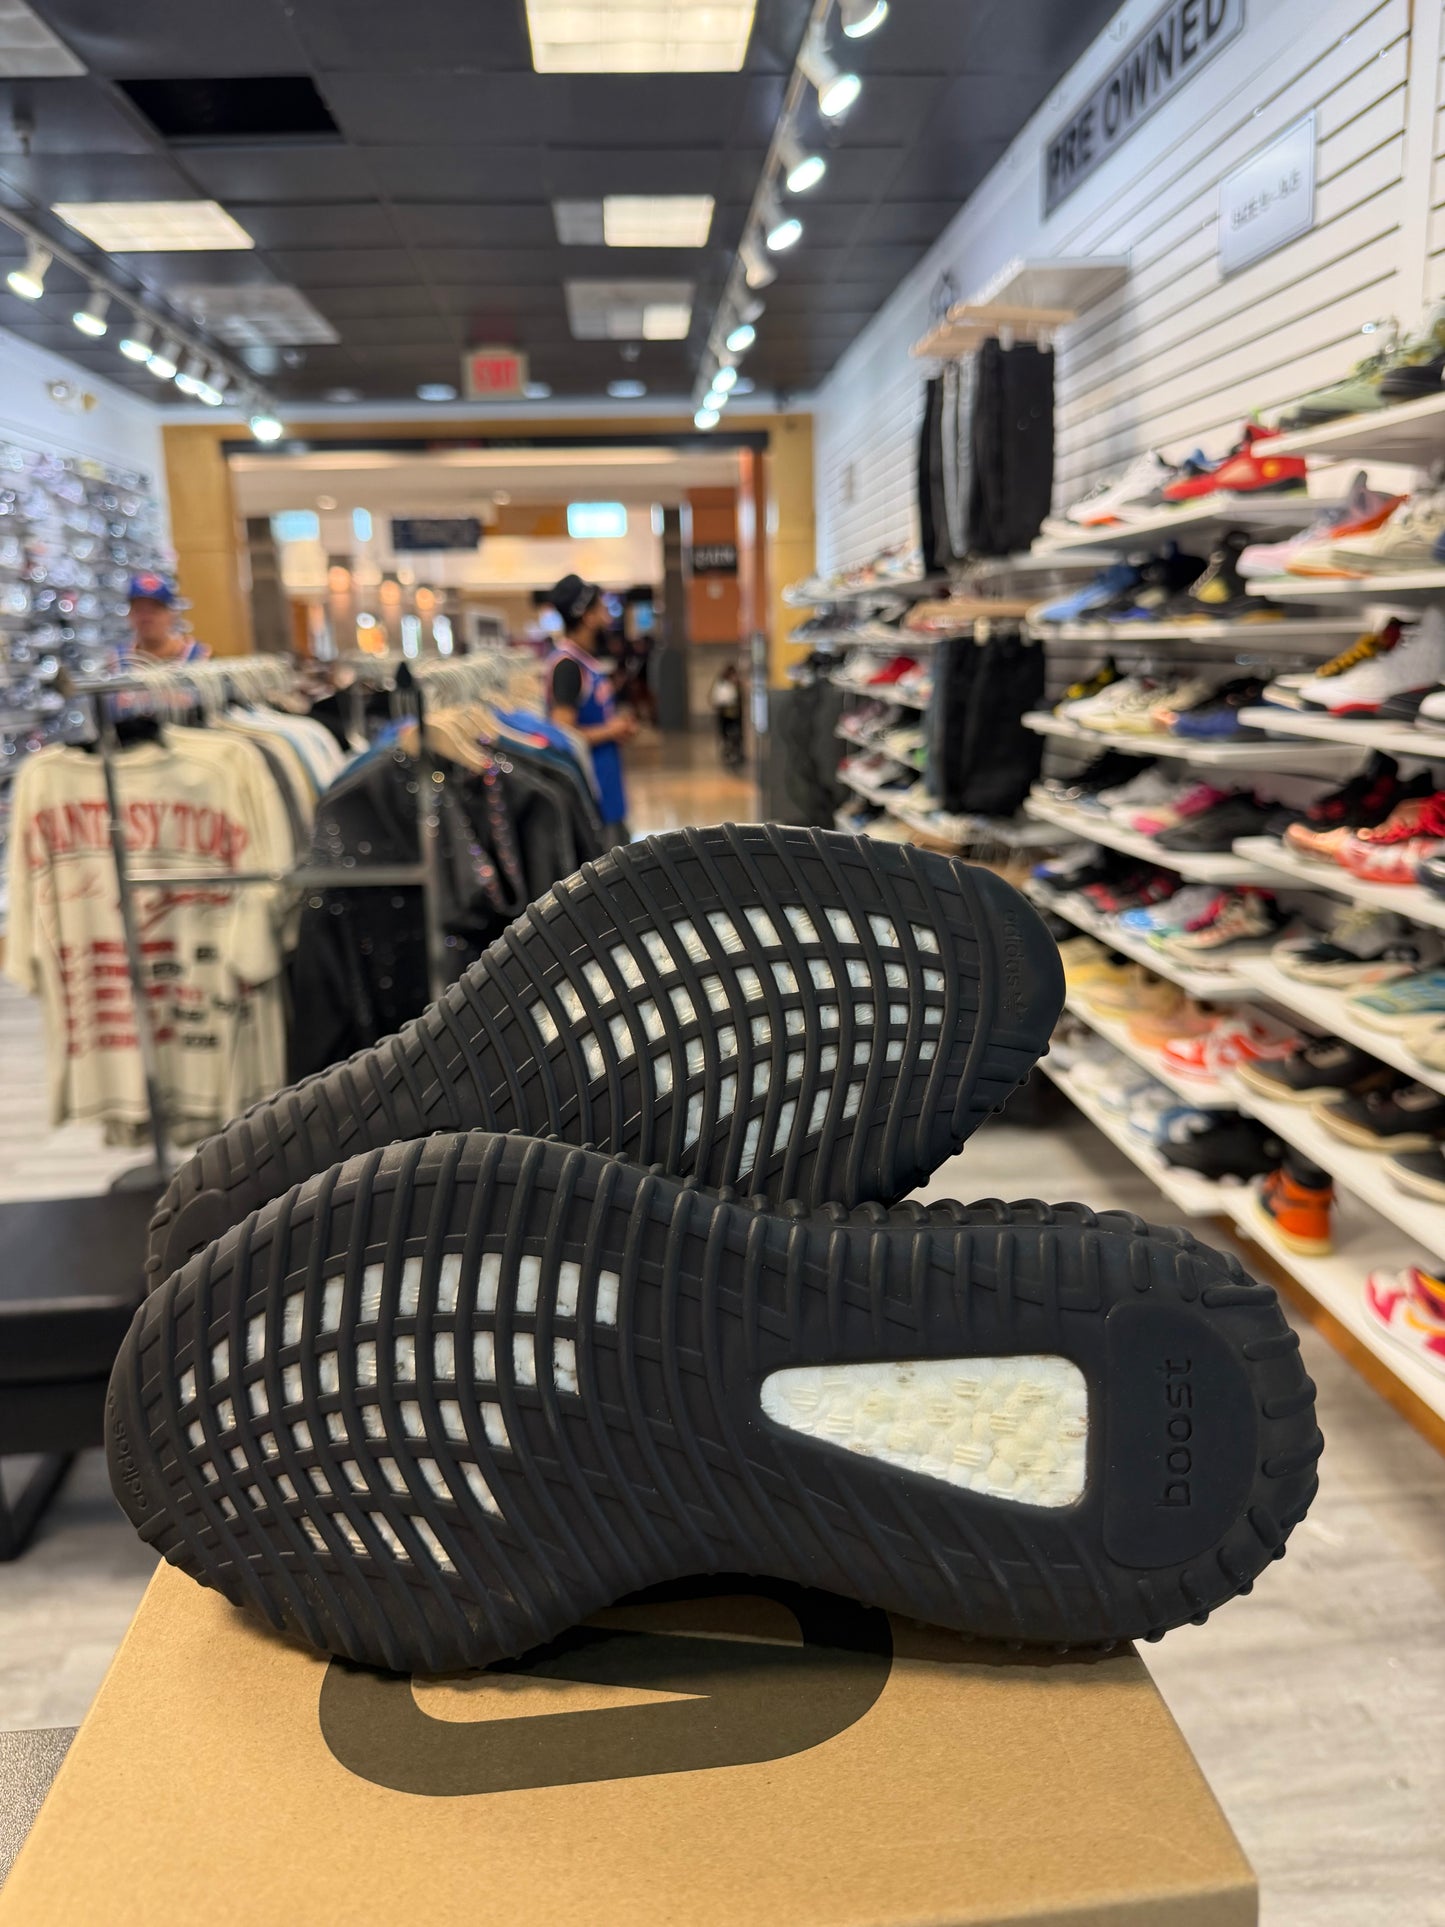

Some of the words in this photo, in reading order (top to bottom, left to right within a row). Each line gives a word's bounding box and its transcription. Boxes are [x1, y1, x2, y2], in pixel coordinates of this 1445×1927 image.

[1049, 107, 1095, 186] PRE
[1103, 0, 1226, 141] OWNED
[1003, 907, 1026, 988] adidas
[112, 1419, 150, 1511] adidas
[1155, 1358, 1193, 1508] boost
